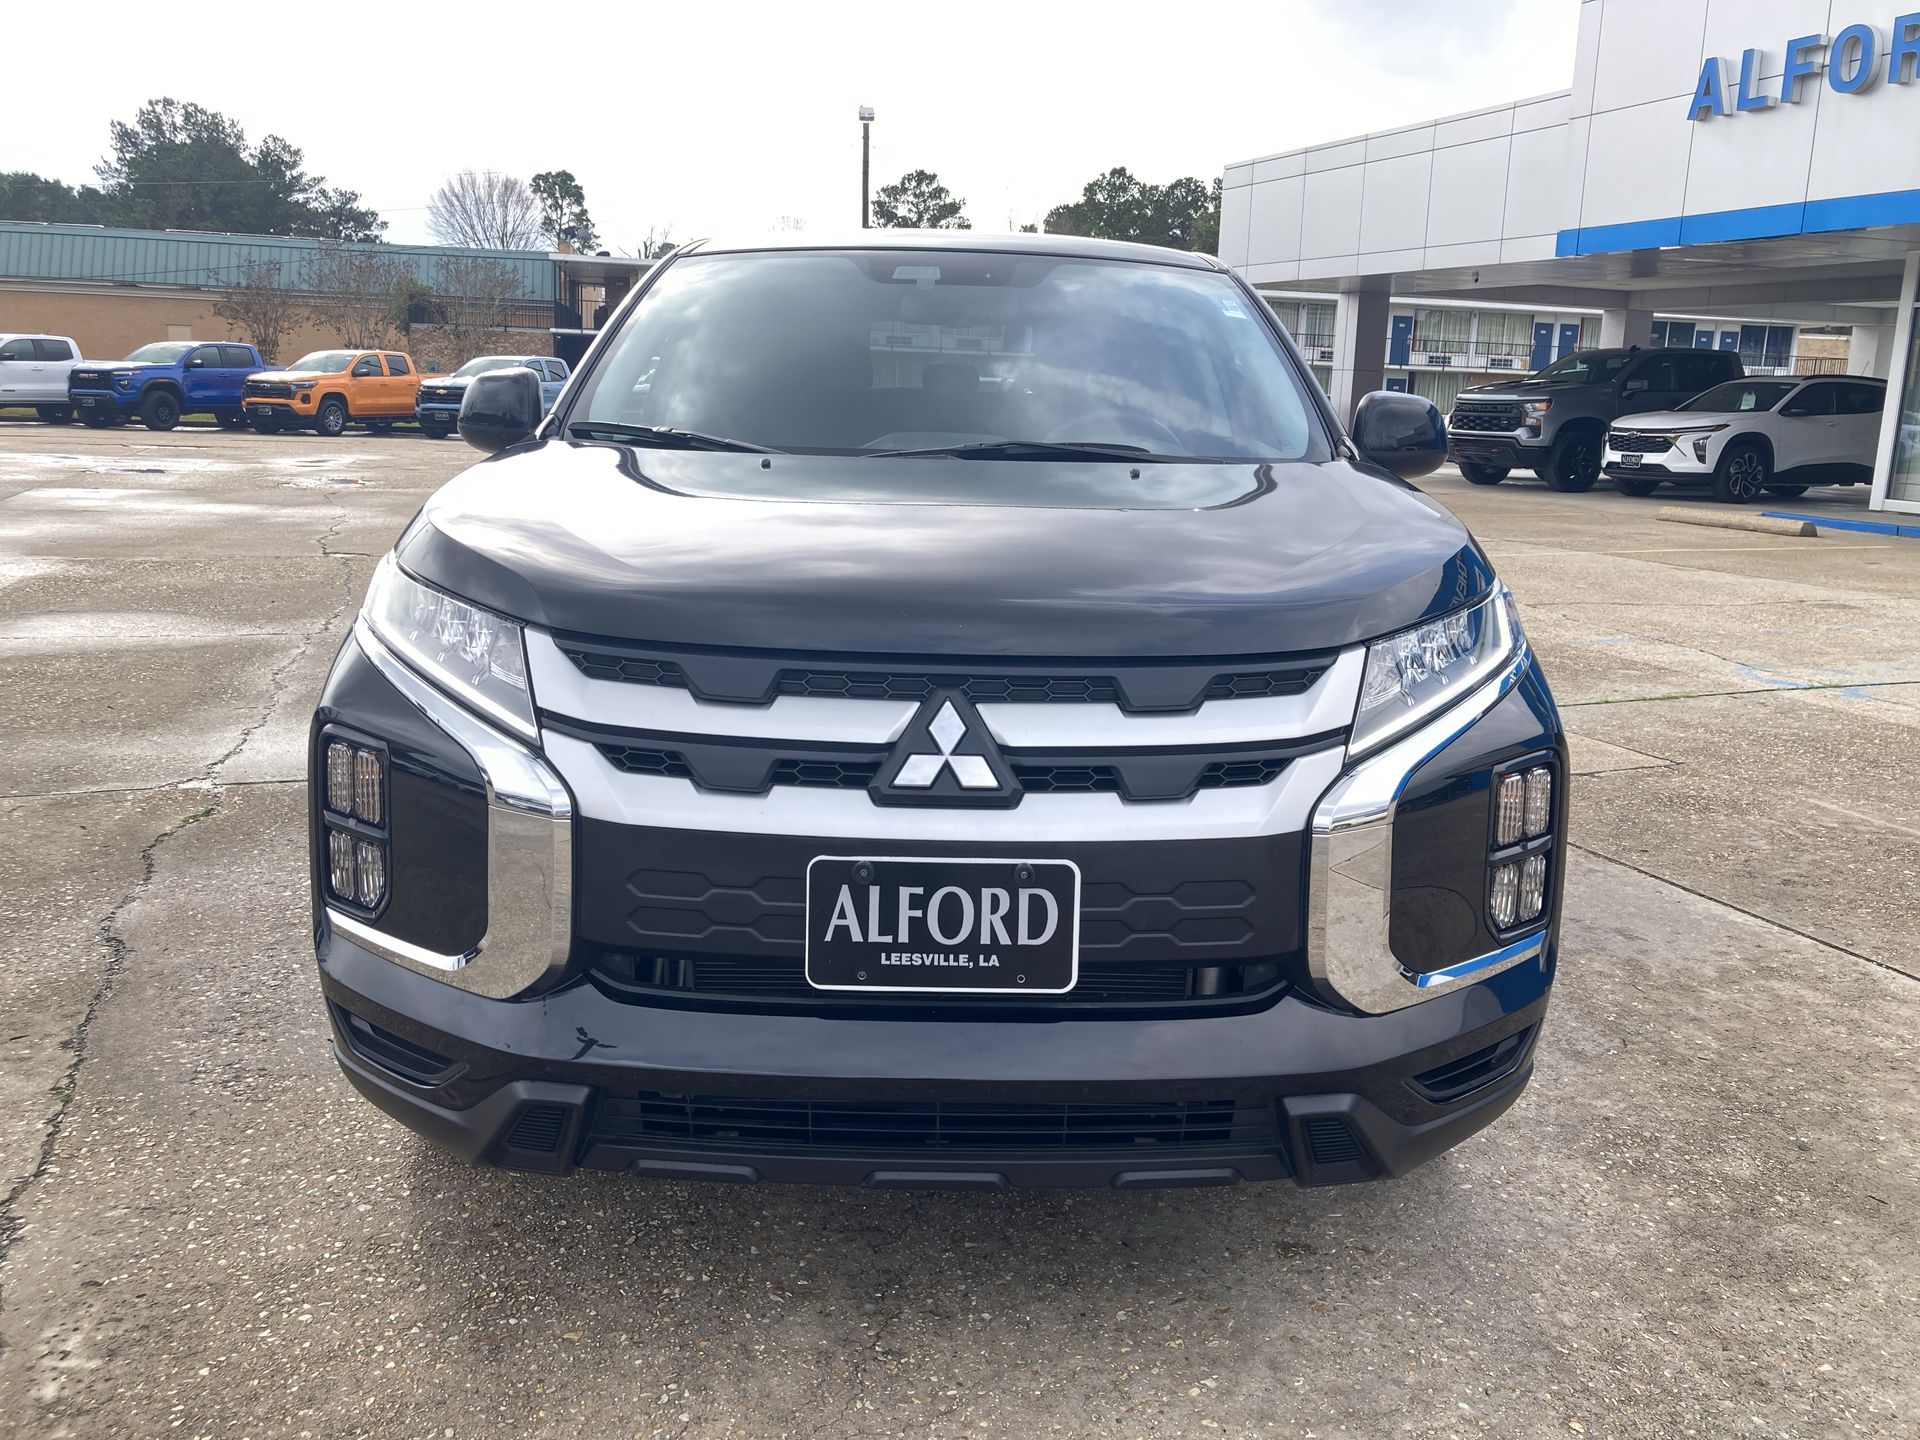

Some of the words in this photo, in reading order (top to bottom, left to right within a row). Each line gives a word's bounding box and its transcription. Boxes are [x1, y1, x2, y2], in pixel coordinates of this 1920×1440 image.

[824, 884, 1059, 946] ALFORD
[880, 952, 974, 969] LEESVILLE,
[979, 954, 1000, 968] LA
